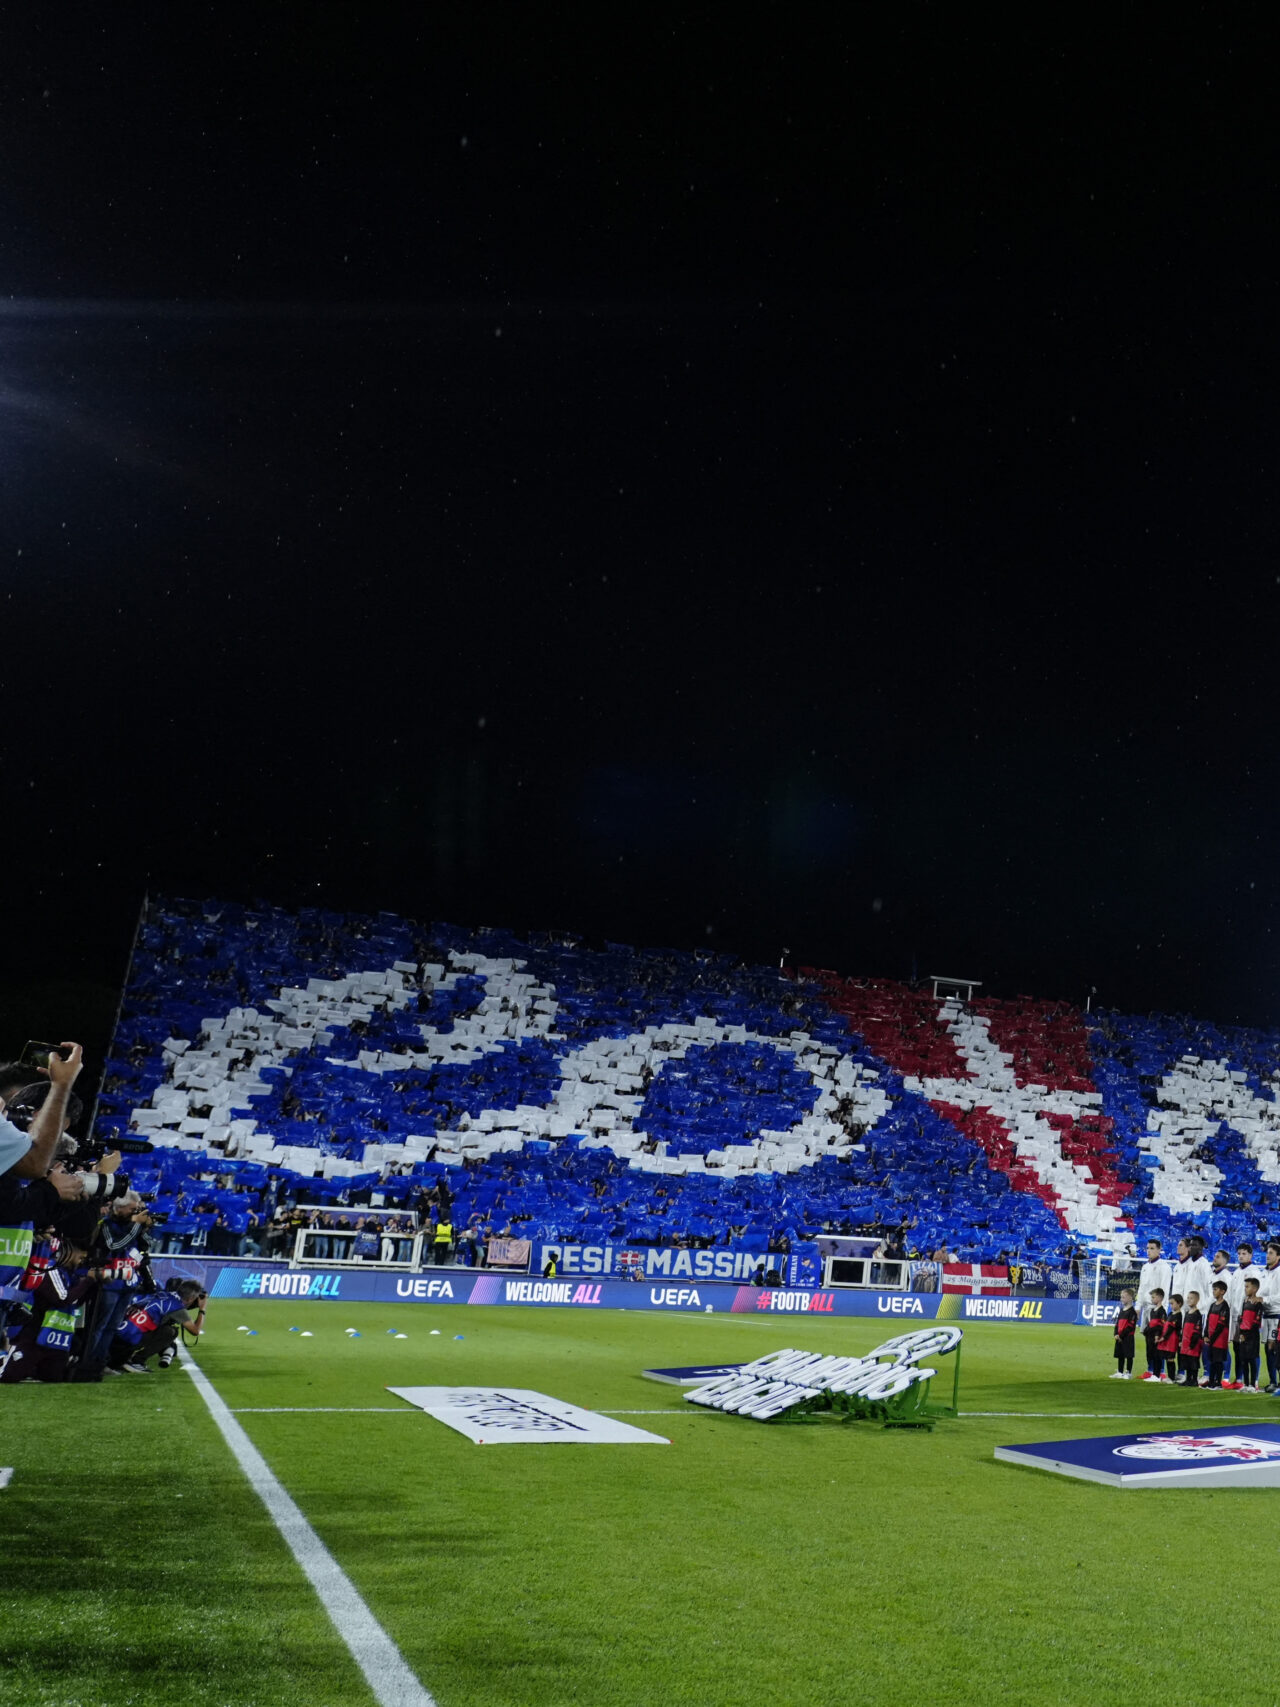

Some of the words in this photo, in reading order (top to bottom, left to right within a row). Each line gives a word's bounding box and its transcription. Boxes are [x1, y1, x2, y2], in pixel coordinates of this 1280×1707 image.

[646, 1249, 775, 1279] MASSIMI
[241, 1273, 342, 1296] #FOOTBALL
[396, 1279, 454, 1298] UEFA
[505, 1281, 574, 1303] WELCOME
[571, 1284, 603, 1304] ALL
[650, 1287, 701, 1306] UEFA
[756, 1291, 835, 1312] #FOOTBALL
[877, 1296, 924, 1314] UEFA
[965, 1298, 1019, 1318] WELCOME
[1018, 1301, 1043, 1319] ALL
[47, 1331, 70, 1347] 011
